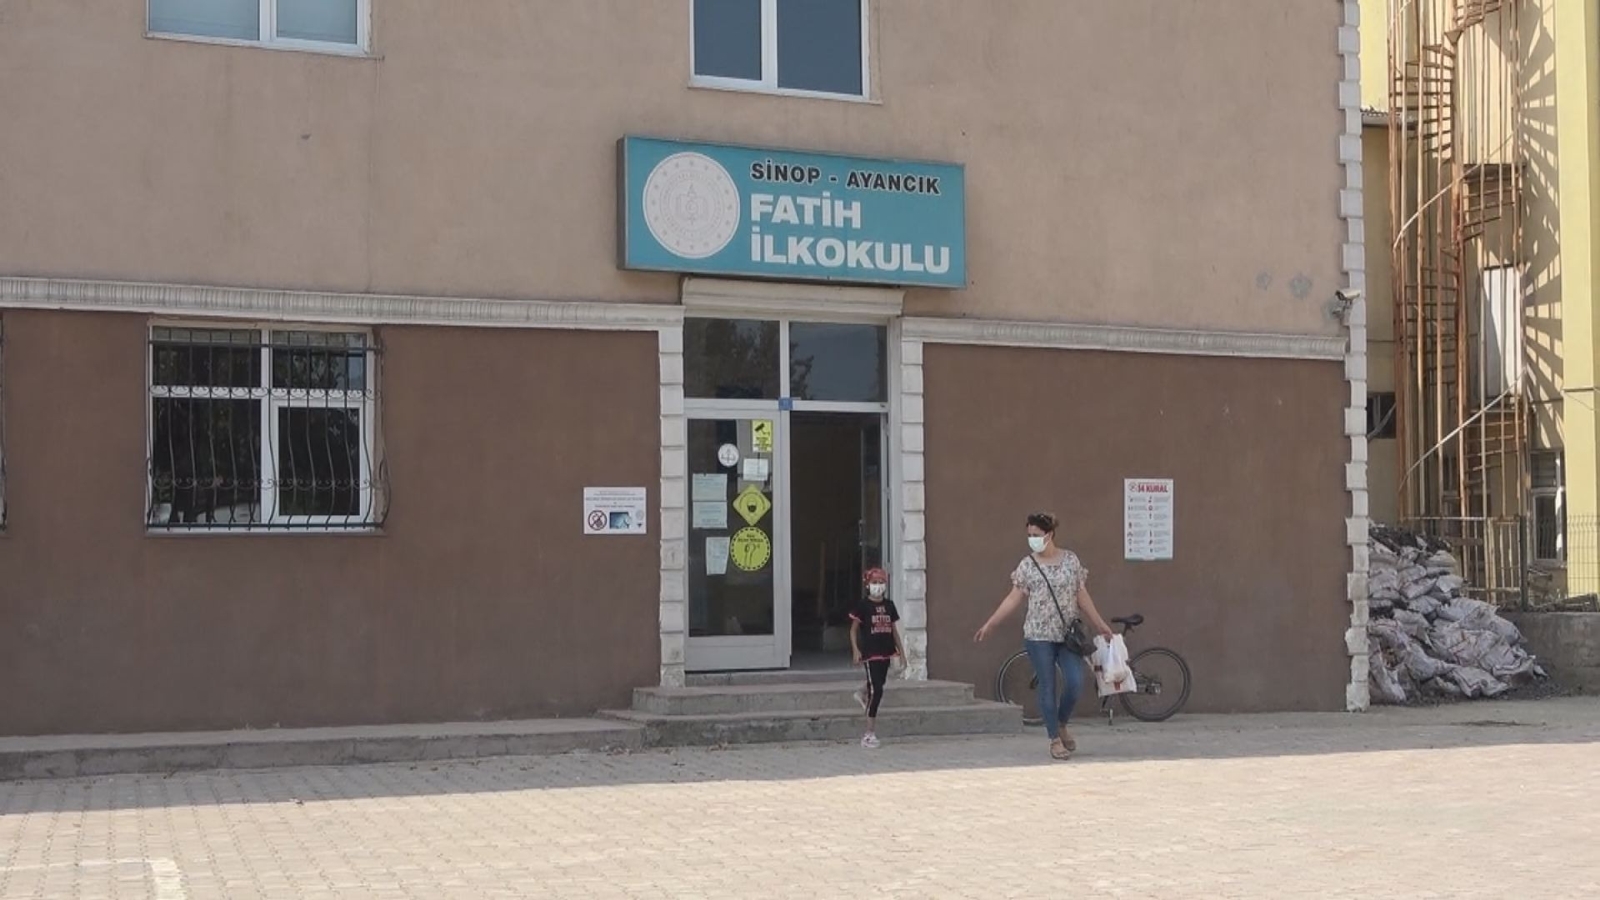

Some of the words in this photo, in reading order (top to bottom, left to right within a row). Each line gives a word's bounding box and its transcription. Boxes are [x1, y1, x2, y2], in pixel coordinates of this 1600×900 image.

[750, 159, 821, 185] SİNOP
[846, 172, 941, 195] AYANCIK
[750, 191, 861, 229] FATİH
[750, 227, 950, 274] İLKOKULU
[1146, 484, 1168, 493] KURAL
